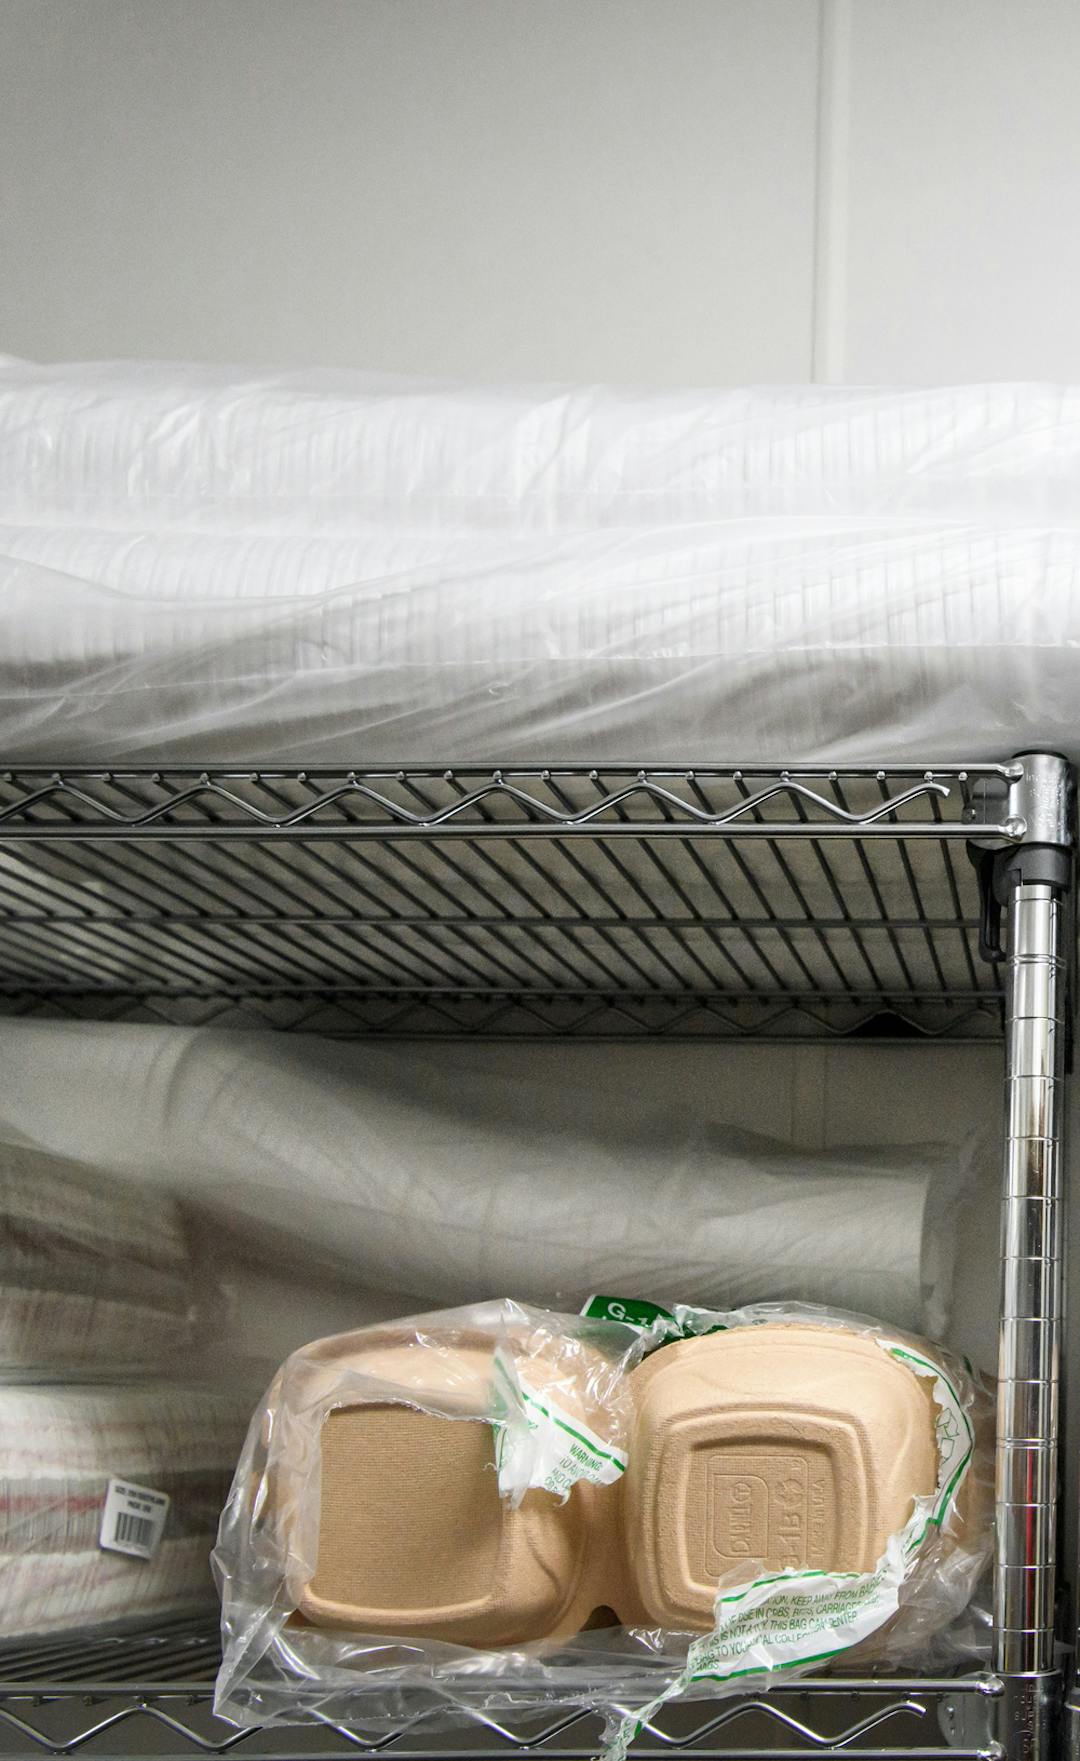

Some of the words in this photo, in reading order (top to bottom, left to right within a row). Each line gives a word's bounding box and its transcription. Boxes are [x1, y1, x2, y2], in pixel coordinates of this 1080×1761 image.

[729, 1624, 746, 1638] NOT
[789, 1618, 807, 1630] BAG
[717, 1645, 728, 1657] TO
